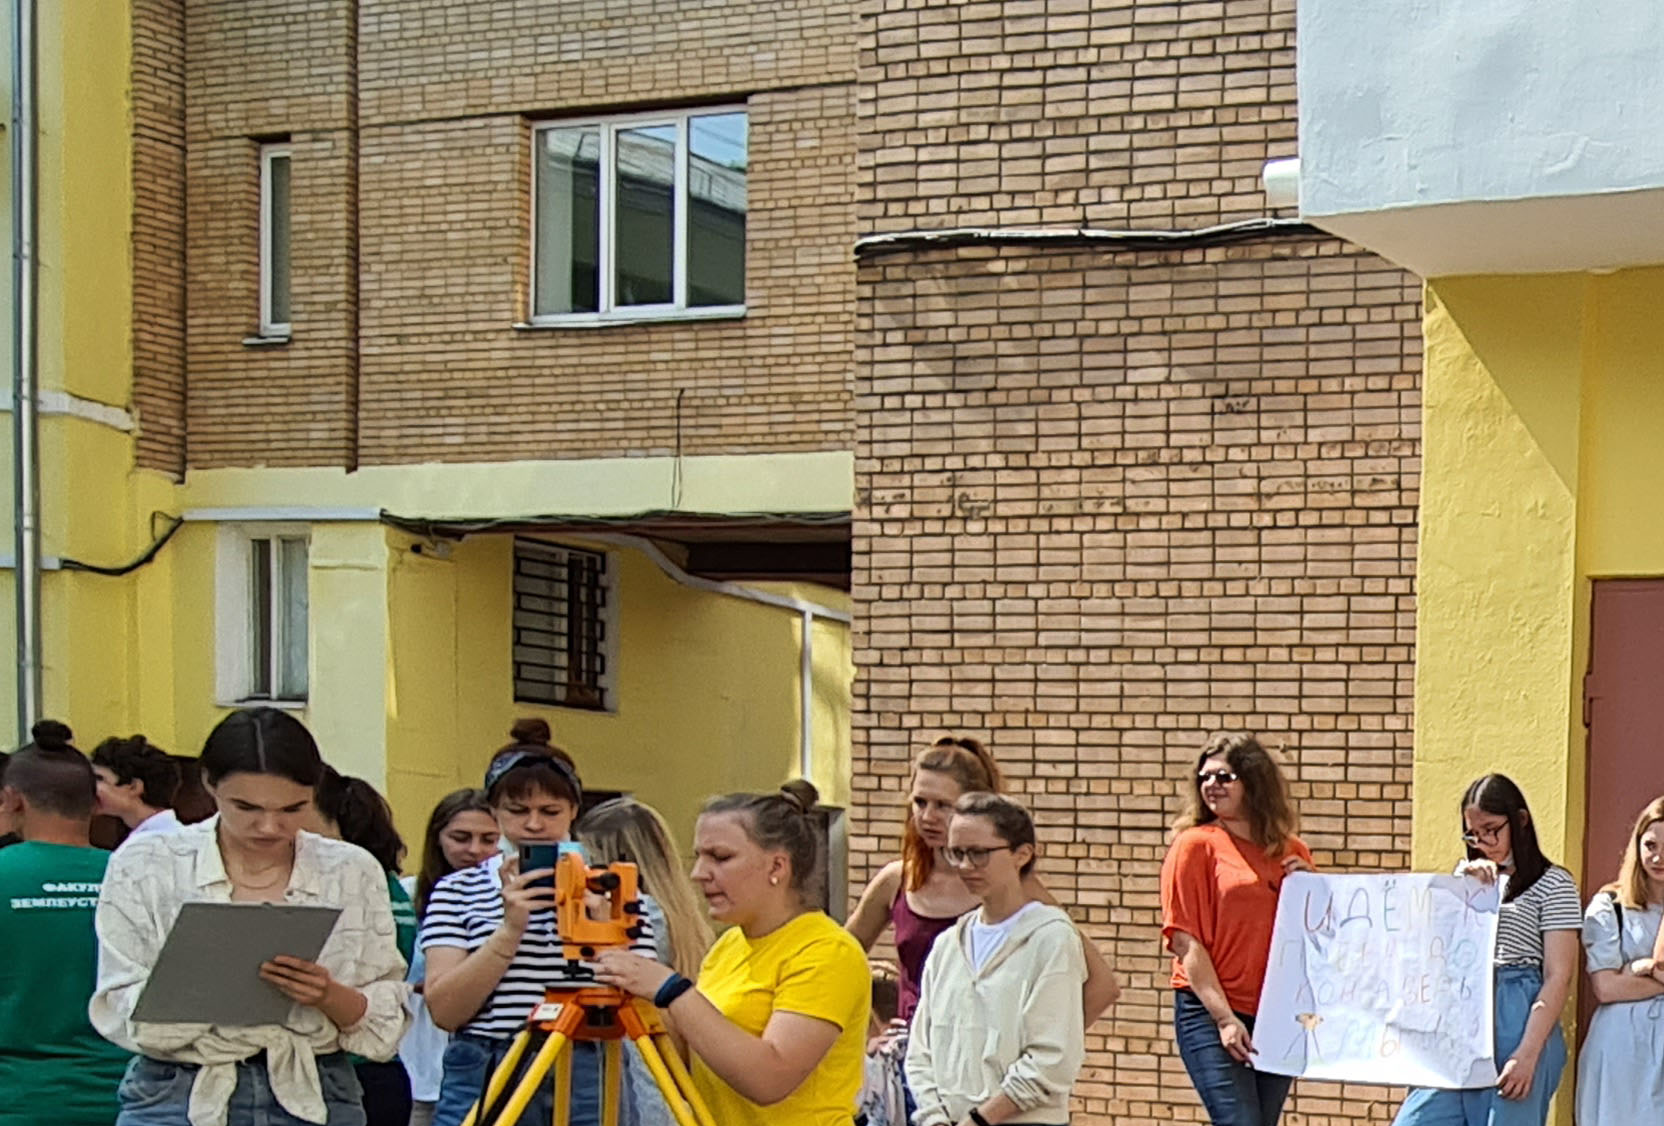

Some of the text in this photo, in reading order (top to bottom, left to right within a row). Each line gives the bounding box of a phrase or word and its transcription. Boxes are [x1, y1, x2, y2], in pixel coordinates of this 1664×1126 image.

[42, 883, 102, 893] ФАКУЛ
[10, 897, 98, 909] ЗЕМЛЕУСТ
[1303, 879, 1433, 933] ИДЁМ
